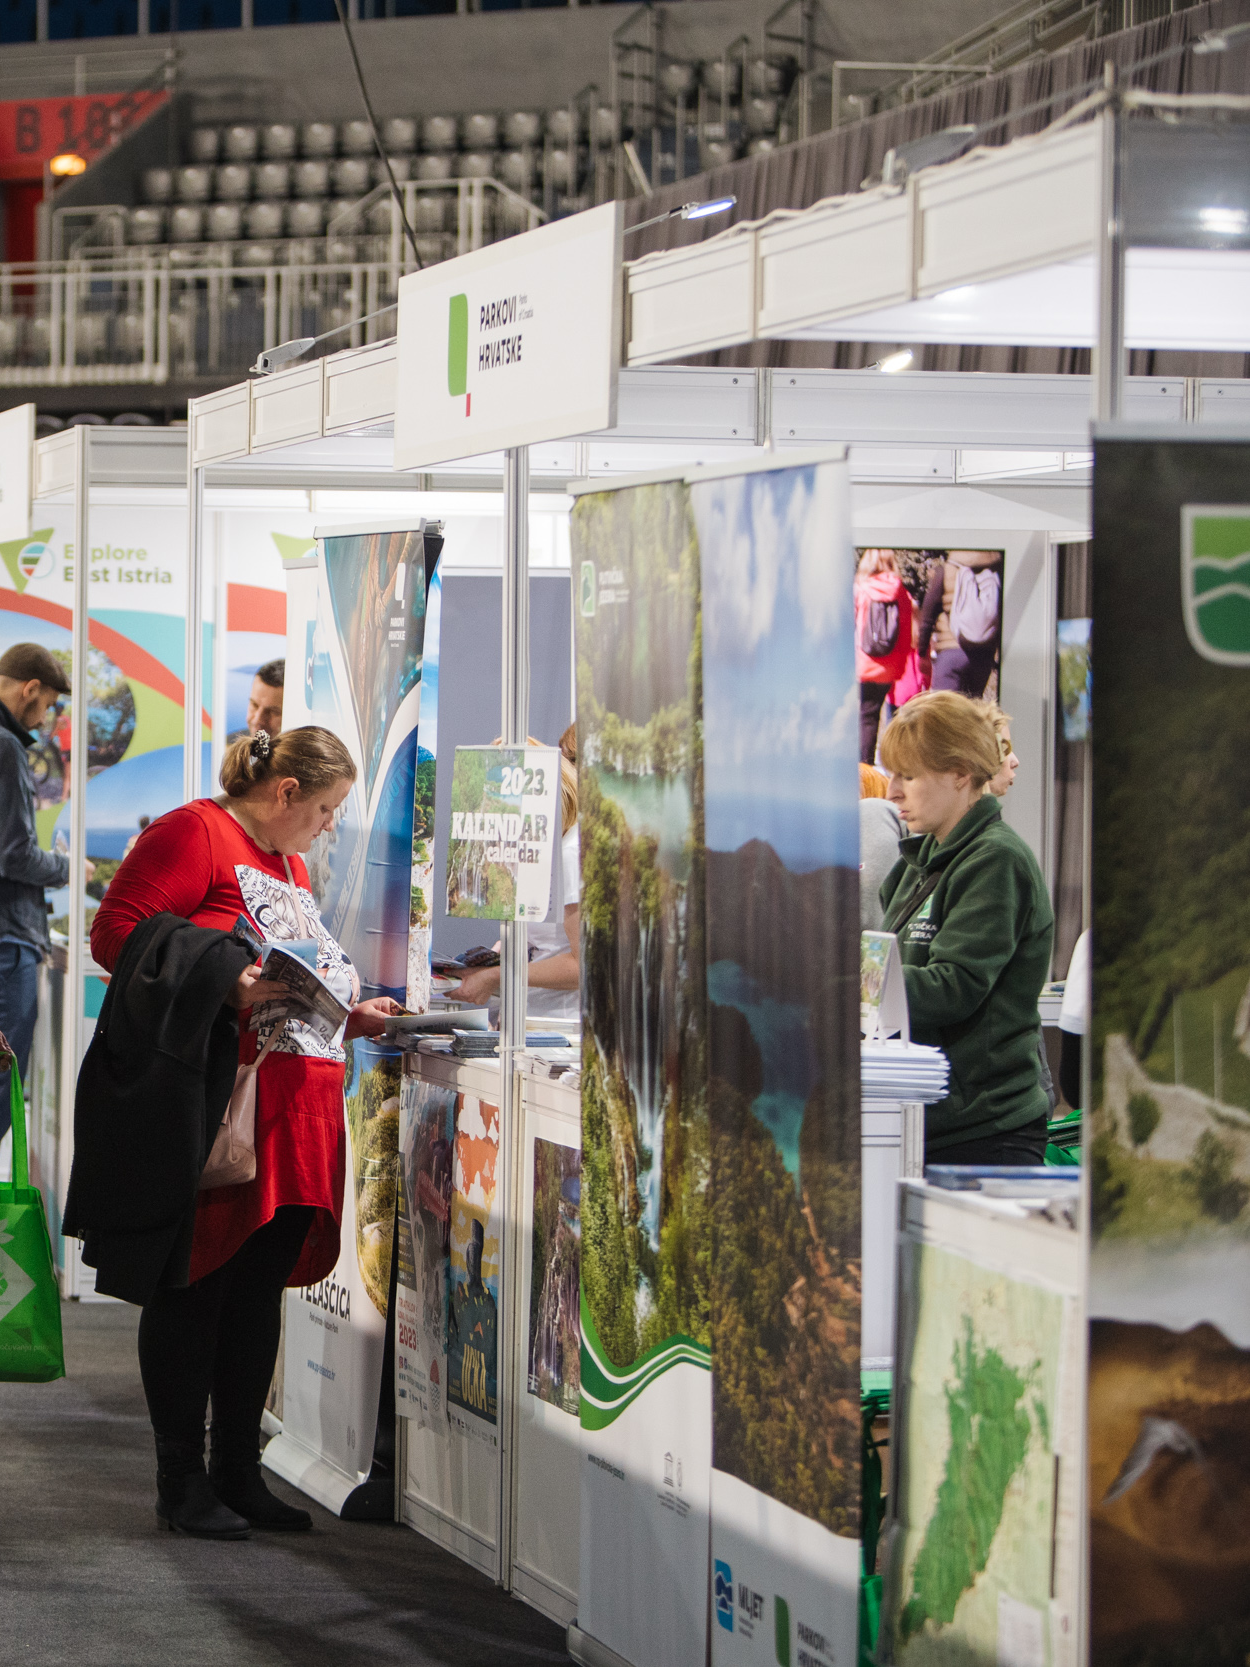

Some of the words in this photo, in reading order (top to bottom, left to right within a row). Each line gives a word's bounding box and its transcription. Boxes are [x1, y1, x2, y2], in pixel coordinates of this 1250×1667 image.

[16, 105, 41, 153] B
[480, 295, 517, 332] PARKOVI
[478, 334, 522, 371] HRVATSKE
[63, 543, 147, 562] Eplore
[63, 567, 110, 582] Est
[118, 567, 172, 583] Istria
[500, 767, 547, 796] 2023.
[451, 811, 547, 842] KALENDAR
[487, 841, 540, 864] calendar
[399, 1323, 417, 1350] 2023
